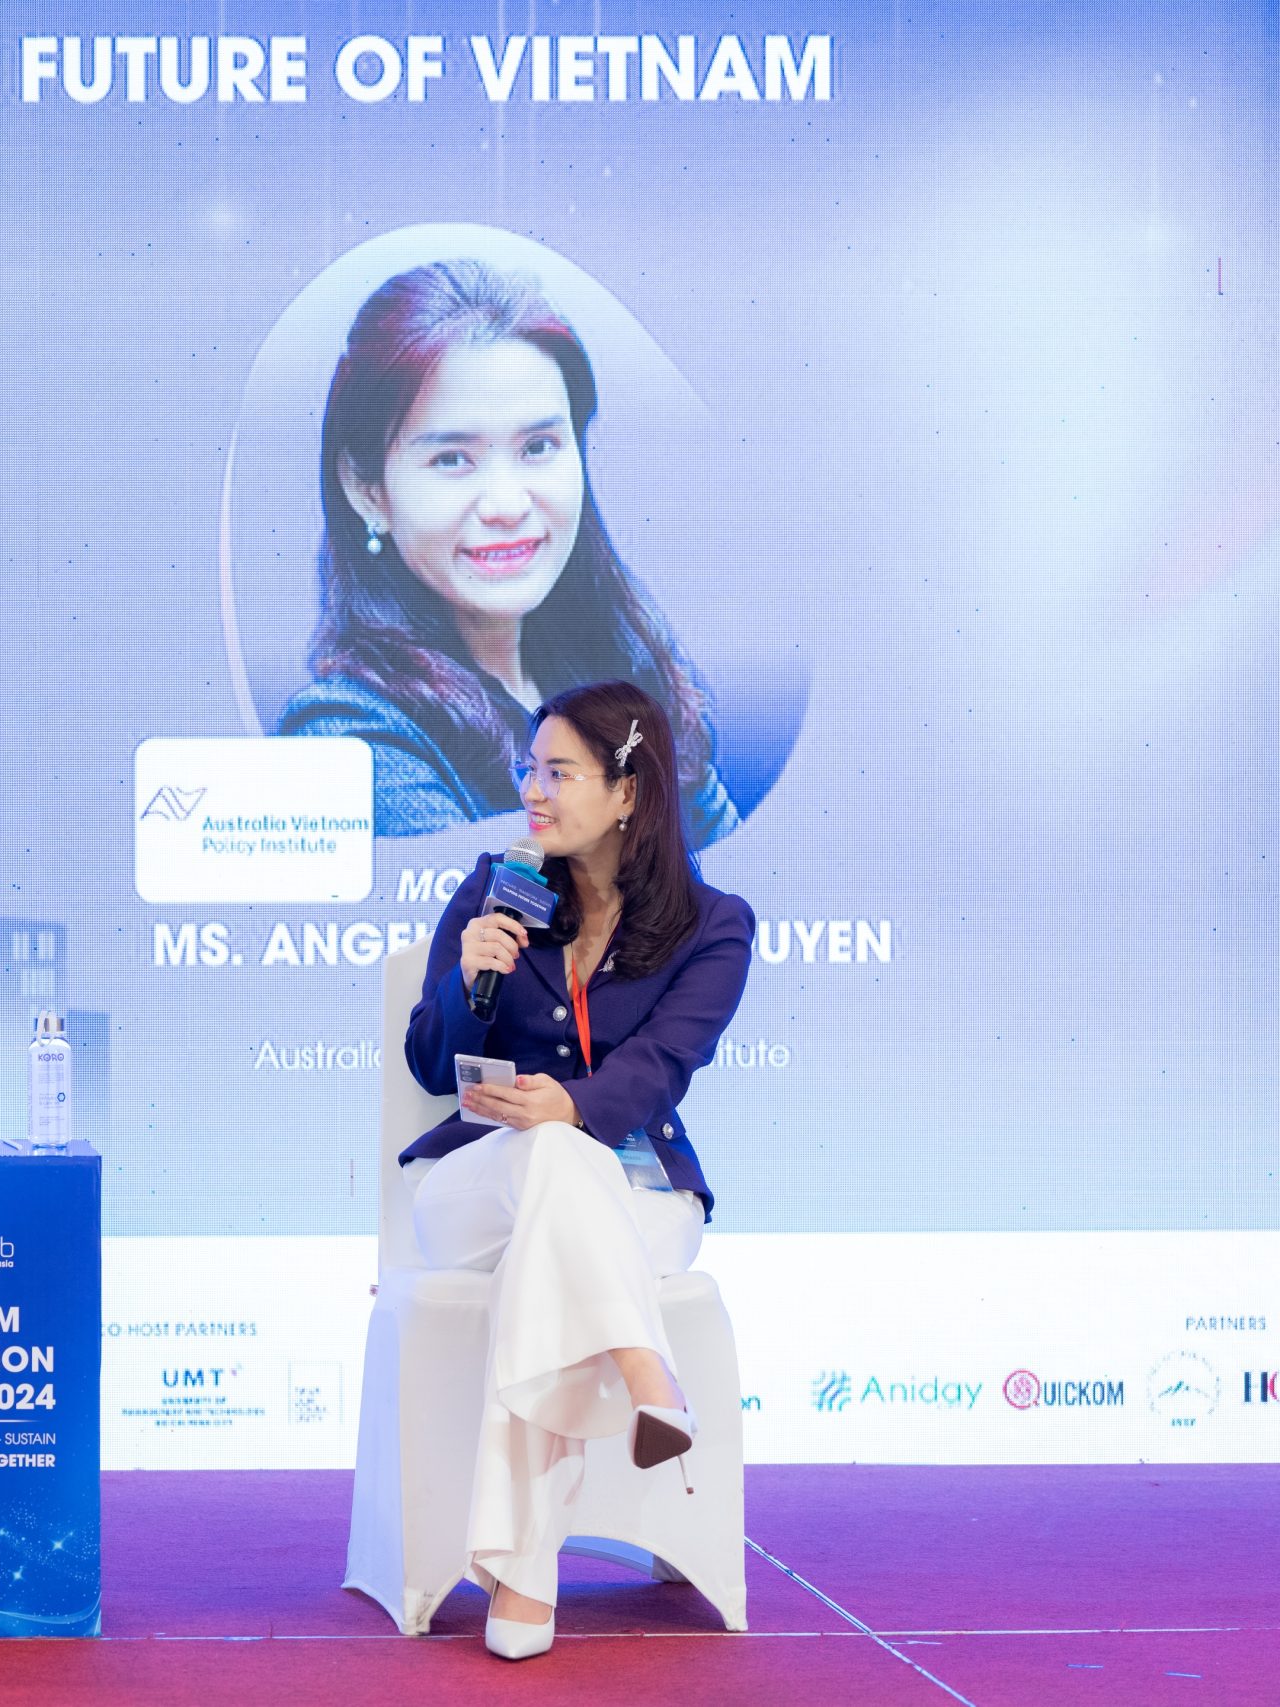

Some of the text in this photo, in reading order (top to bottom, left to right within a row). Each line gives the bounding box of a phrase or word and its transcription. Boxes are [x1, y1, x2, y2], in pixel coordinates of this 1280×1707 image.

[20, 35, 308, 103] FUTURE
[336, 35, 444, 103] OF
[470, 35, 834, 103] VIETNAM
[202, 816, 370, 832] Australia Vietnam
[202, 837, 337, 856] Policy Institute
[153, 922, 242, 967] MS.
[751, 919, 891, 964] UYEN
[711, 1038, 791, 1068] itute
[175, 1322, 258, 1337] PARTNERS
[1185, 1316, 1267, 1331] PARTNERS
[163, 1367, 225, 1388] UMT
[861, 1374, 983, 1410] Aniday
[5, 1432, 56, 1445] SUSTAIN
